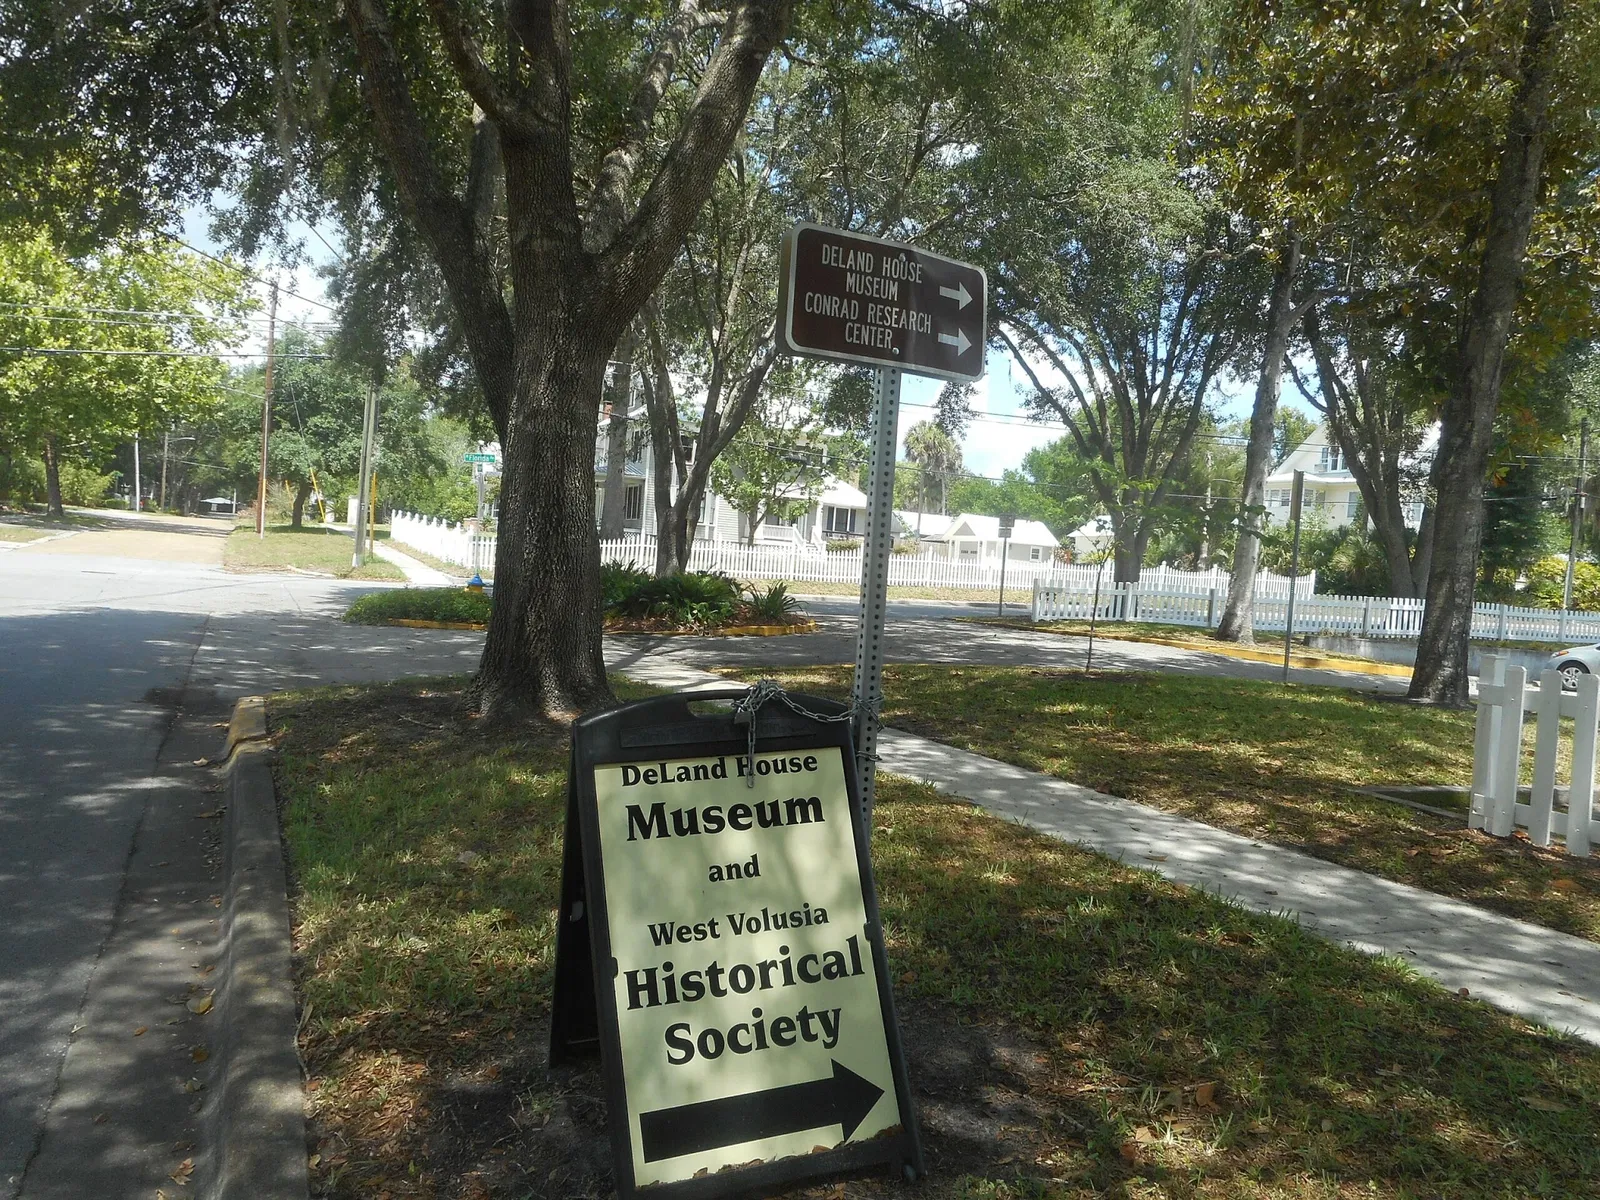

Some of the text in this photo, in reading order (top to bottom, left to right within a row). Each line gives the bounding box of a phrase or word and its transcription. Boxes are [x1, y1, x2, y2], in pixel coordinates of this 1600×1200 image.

[822, 244, 923, 284] DELAND HOUSE
[846, 272, 899, 301] MUSEUM
[804, 292, 932, 334] CONRAD RESEARCH
[845, 322, 893, 349] CENTER
[468, 454, 490, 462] Florida
[620, 755, 818, 787] DeLand House
[625, 796, 825, 842] Museum
[708, 853, 761, 882] and
[648, 902, 830, 946] West Volusia
[623, 934, 865, 1010] Historical
[664, 1005, 841, 1065] Society
